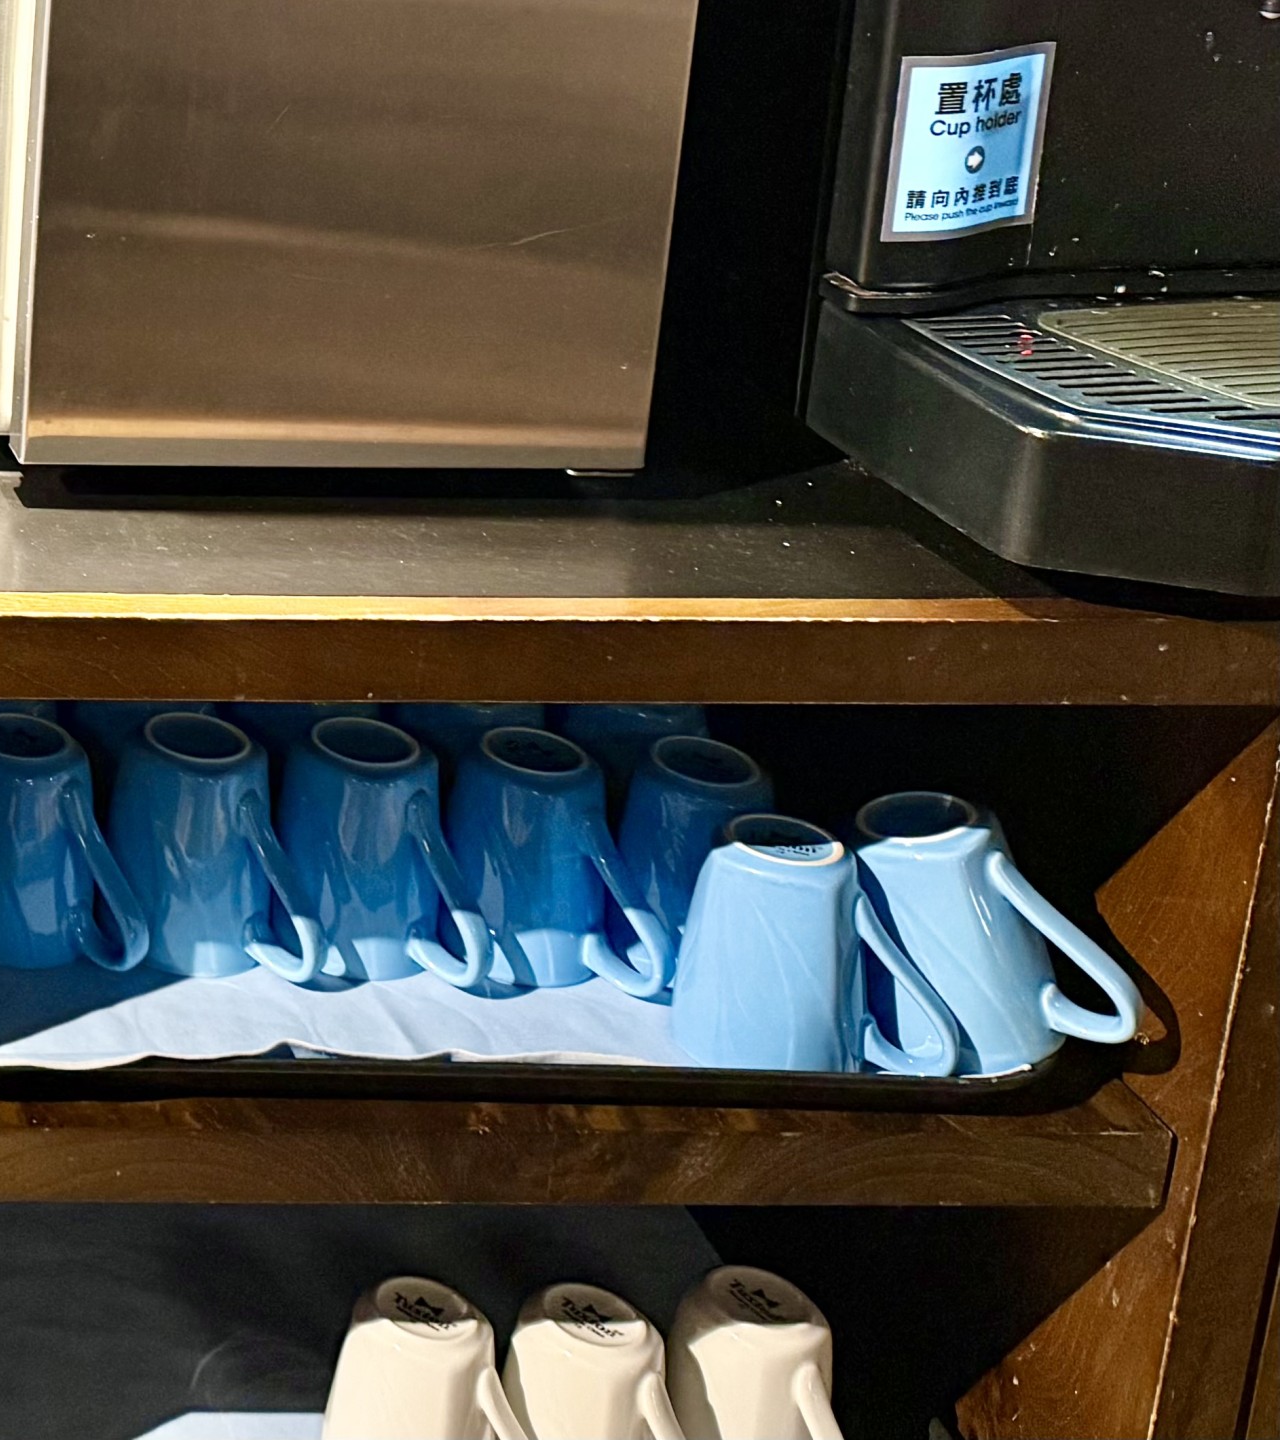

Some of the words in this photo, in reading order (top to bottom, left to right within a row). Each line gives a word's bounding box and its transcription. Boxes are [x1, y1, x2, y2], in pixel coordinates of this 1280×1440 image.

[935, 72, 1023, 115] 置杯處
[930, 118, 971, 138] Cup
[975, 110, 1022, 133] holder
[905, 212, 939, 222] Please
[942, 209, 964, 222] push
